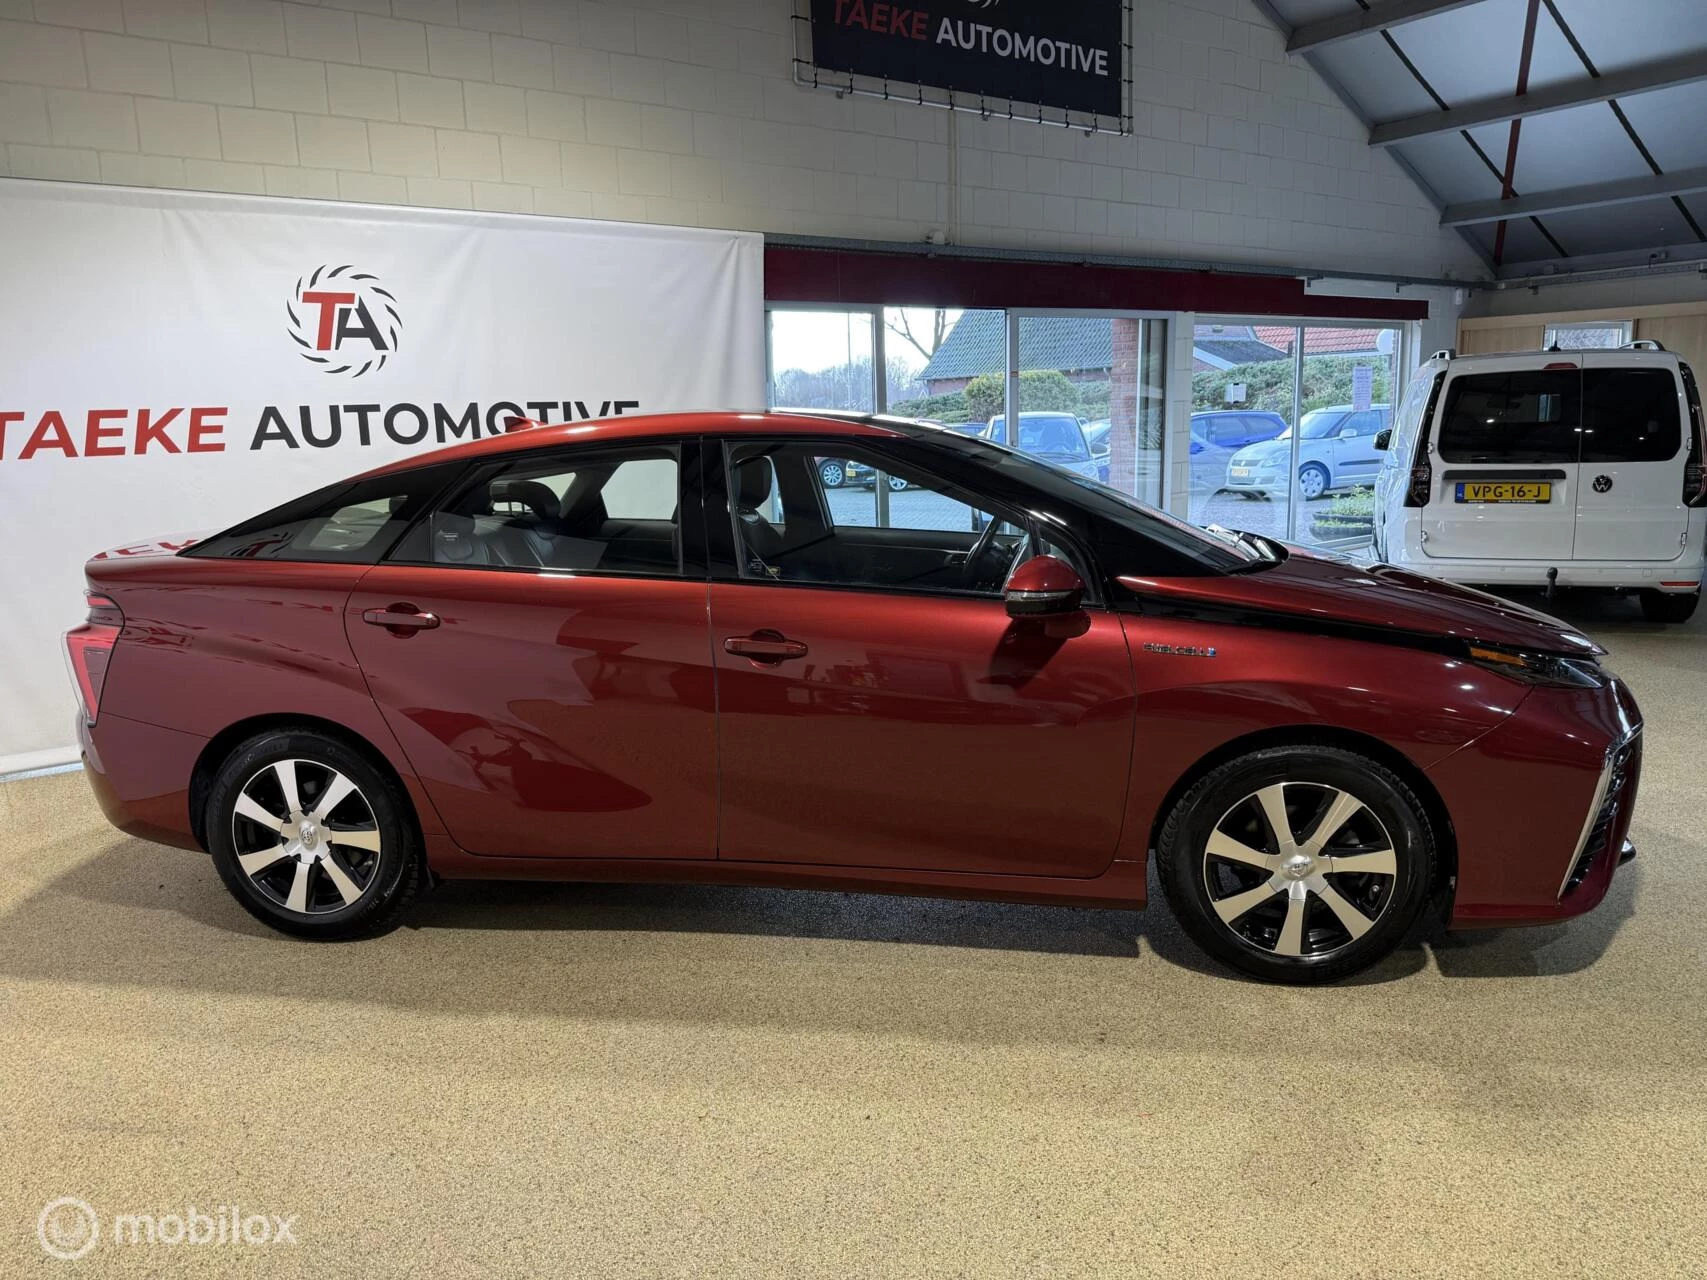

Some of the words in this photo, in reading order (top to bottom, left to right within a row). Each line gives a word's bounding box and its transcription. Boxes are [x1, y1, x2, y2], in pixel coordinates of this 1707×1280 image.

[935, 17, 1109, 77] AUTOMOTIVE
[302, 291, 389, 351] TA
[1472, 485, 1541, 498] VPG-16-J
